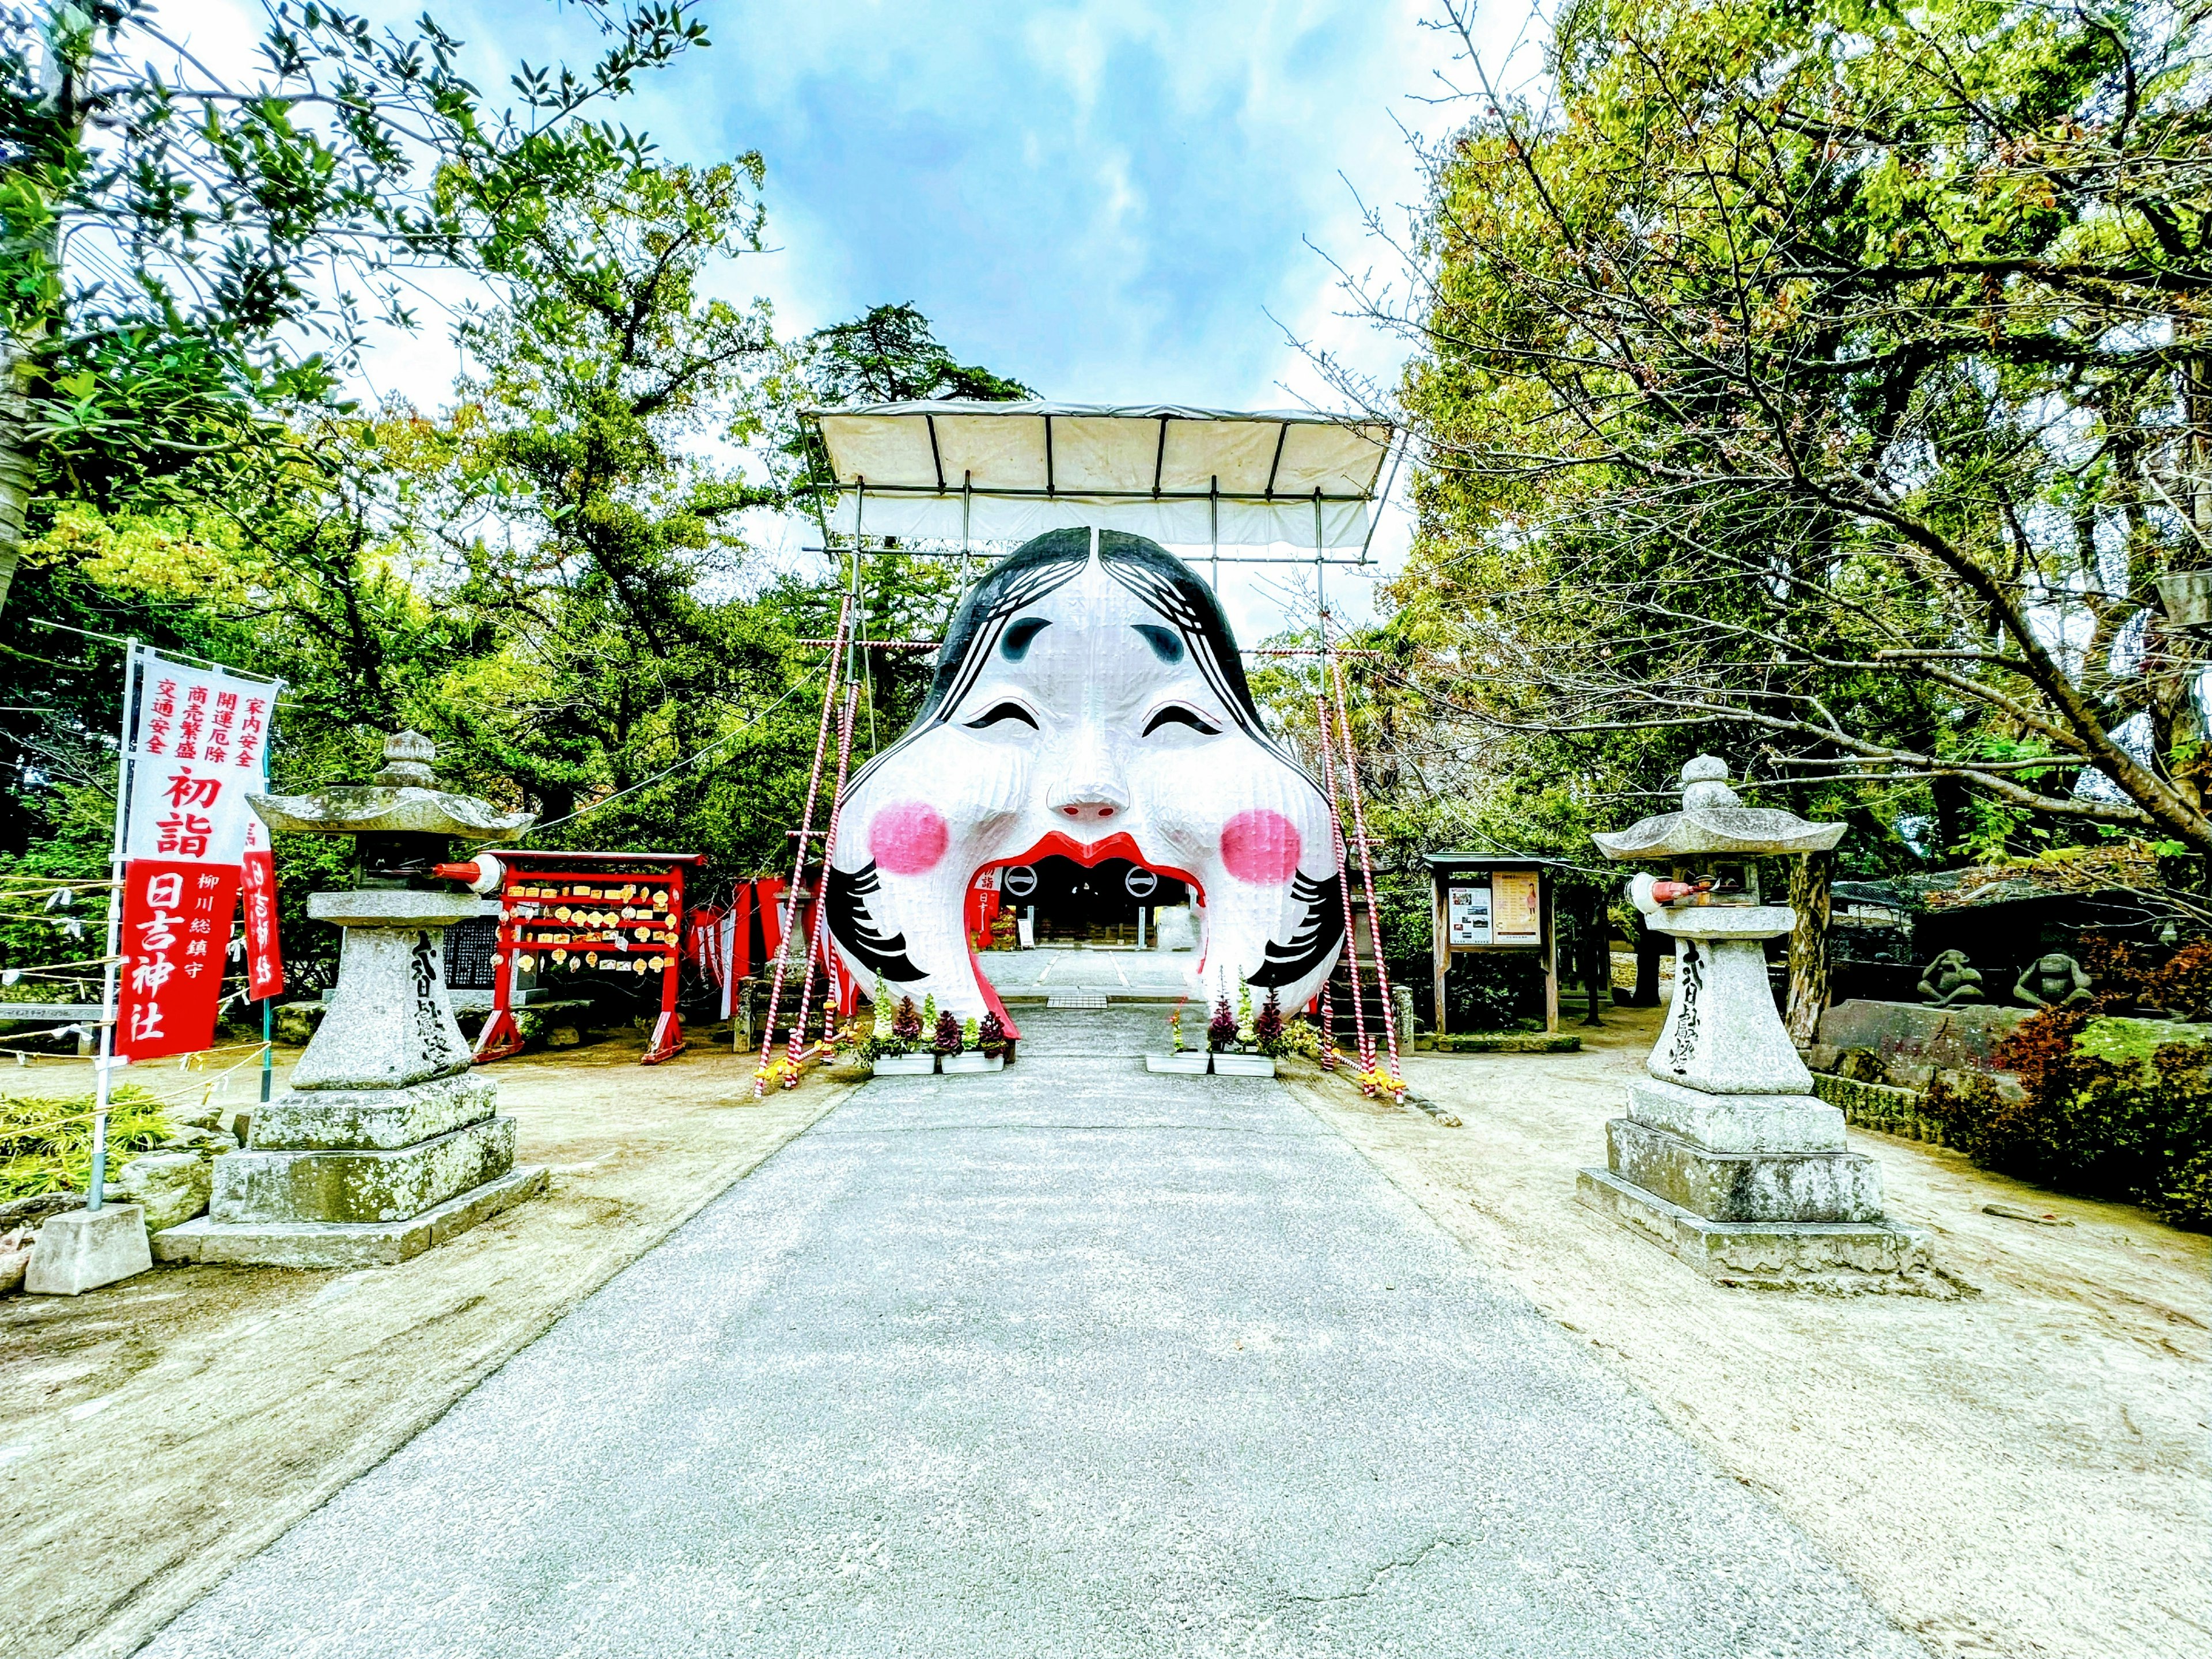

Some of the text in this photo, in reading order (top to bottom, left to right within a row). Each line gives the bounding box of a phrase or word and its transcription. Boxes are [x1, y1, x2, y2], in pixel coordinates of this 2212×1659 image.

[145, 678, 177, 755] 交通安全
[175, 685, 209, 759] 商売繁盛
[204, 691, 238, 763] 開運厄除
[235, 697, 266, 768] 家内安全
[156, 766, 222, 858] 初詣
[132, 873, 185, 1043] 日吉神社
[184, 873, 219, 978] 柳川総鎮守
